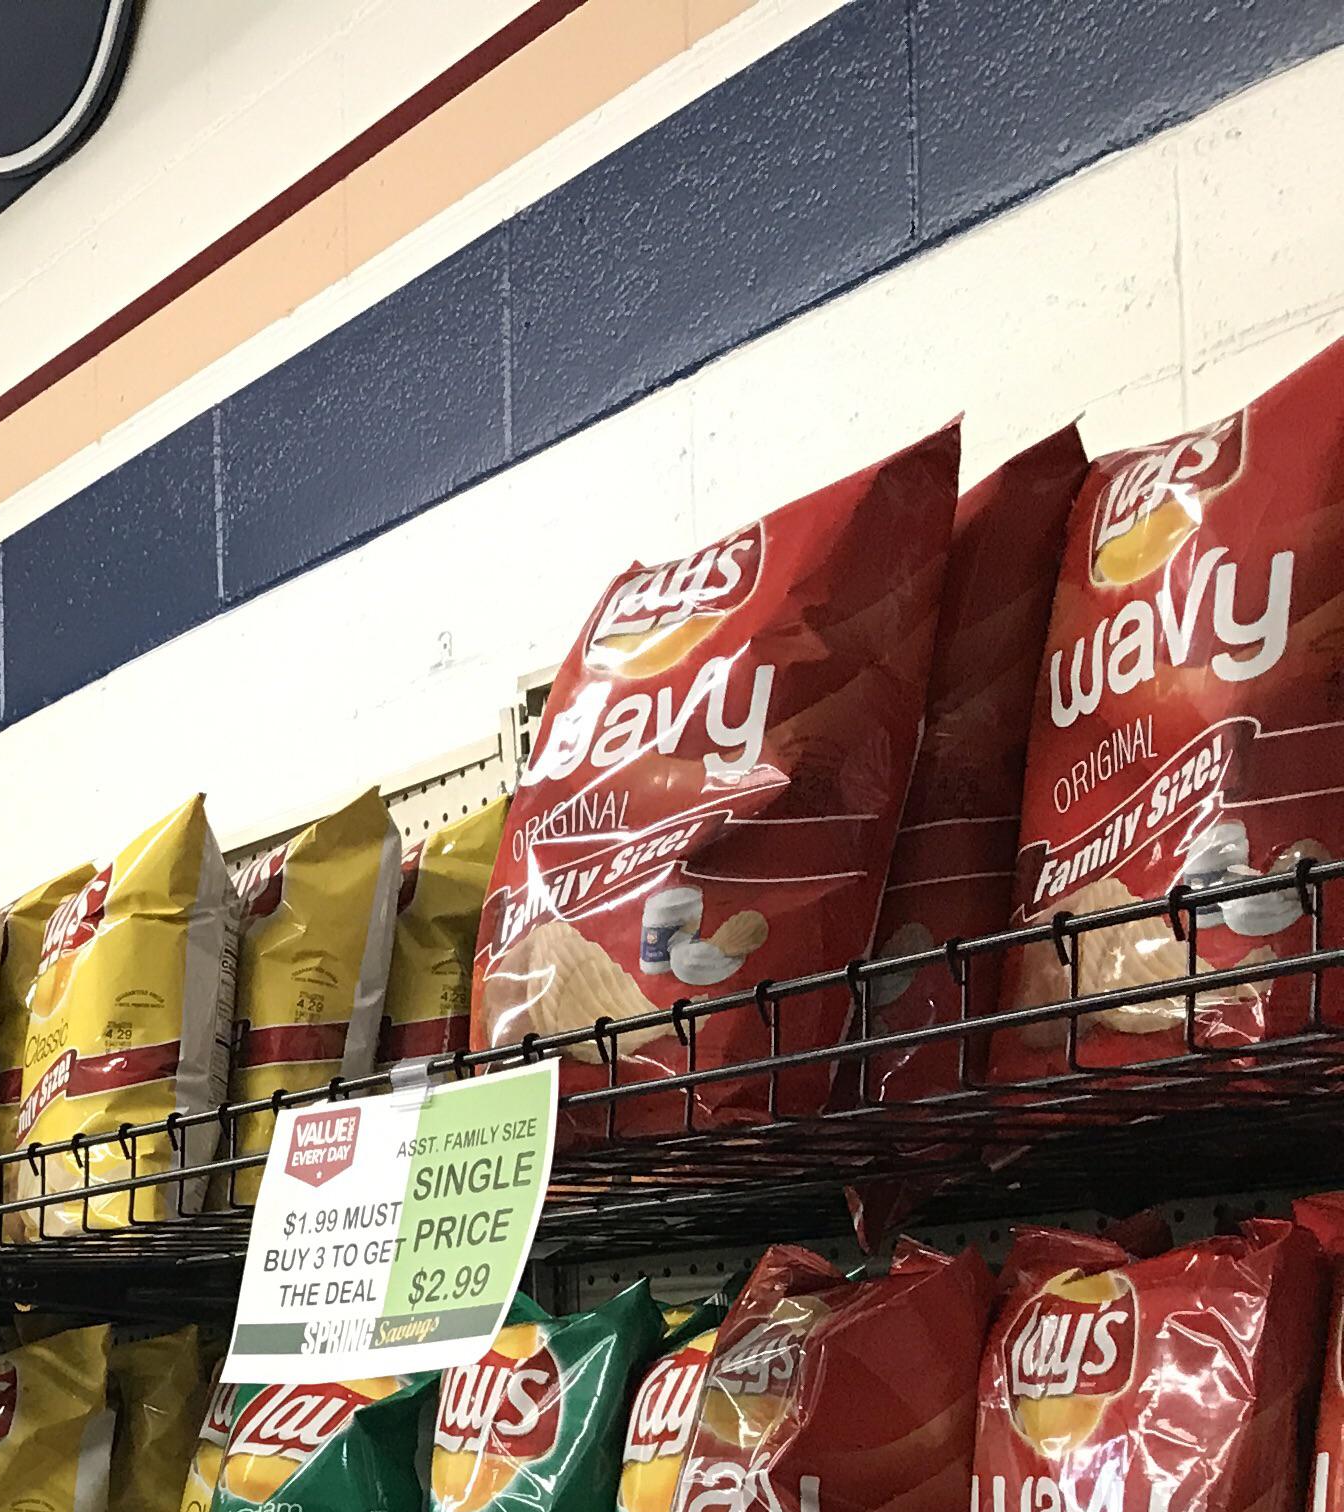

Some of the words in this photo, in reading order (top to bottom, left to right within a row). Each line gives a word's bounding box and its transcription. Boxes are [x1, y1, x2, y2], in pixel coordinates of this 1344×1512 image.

[1049, 546, 1293, 728] wavy
[1053, 713, 1158, 814] ORIGINAL
[512, 789, 629, 861] ORIGINAL
[1033, 805, 1140, 904] Family
[1150, 735, 1223, 817] Size!
[610, 821, 701, 881] Size!
[297, 1117, 348, 1147] VALUE
[396, 1137, 439, 1160] ASST.
[444, 1125, 499, 1150] FAMILY
[502, 1118, 537, 1141] SIZE
[291, 1148, 328, 1168] EVERY
[327, 1145, 352, 1163] DAY
[413, 1151, 535, 1202] SINGLE
[283, 1209, 339, 1240] $1.99
[343, 1202, 403, 1230] MUST
[413, 1208, 514, 1252] PRICE
[263, 1246, 309, 1273] BUY
[313, 1245, 325, 1269] 3
[332, 1243, 358, 1267] TO
[363, 1238, 406, 1265] GET
[279, 1283, 319, 1307] THE
[324, 1279, 377, 1304] DEAL
[408, 1263, 491, 1311] $2.99
[300, 1317, 376, 1355] SPRING
[374, 1315, 441, 1348] Savings
